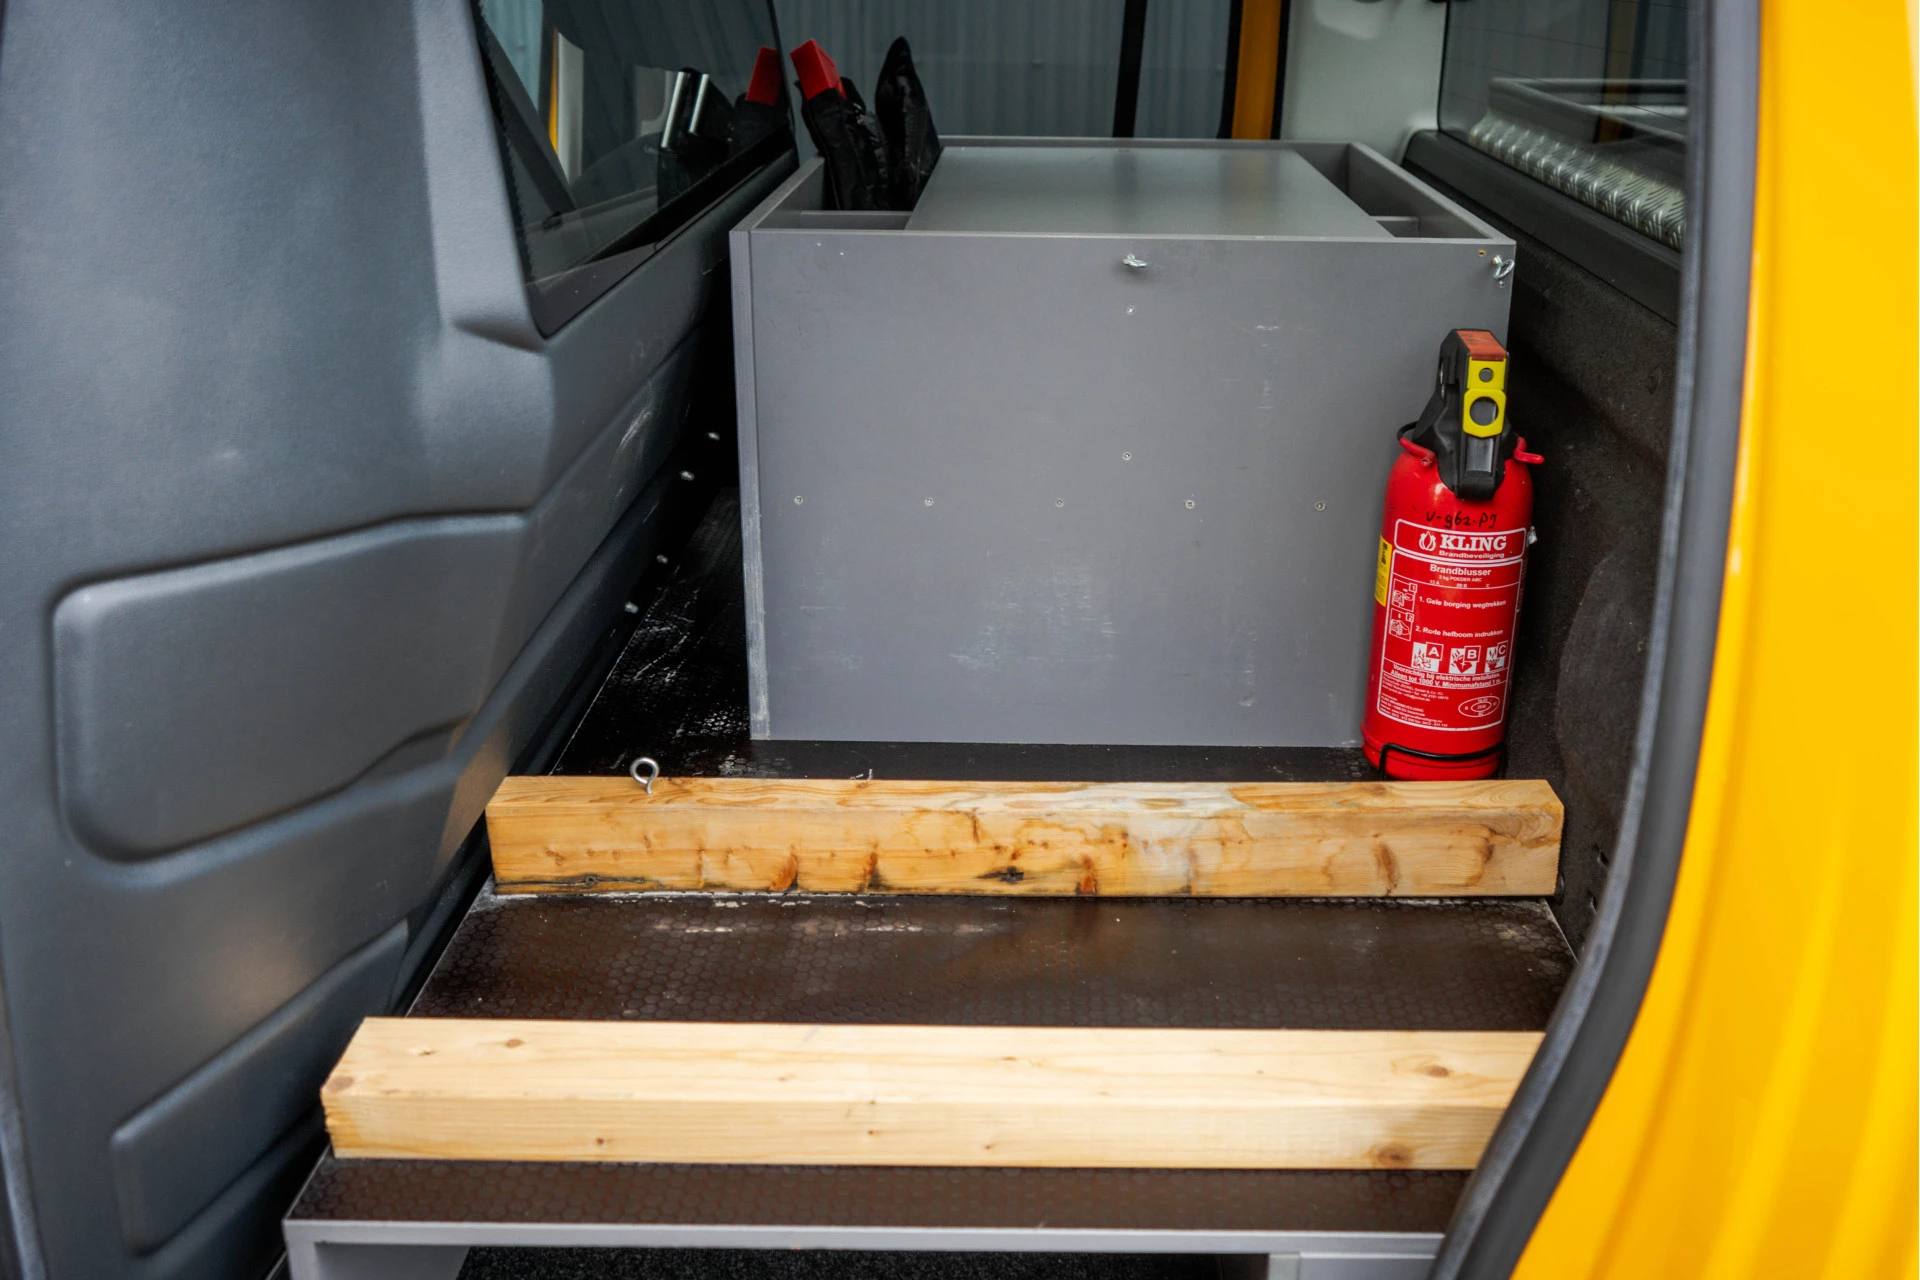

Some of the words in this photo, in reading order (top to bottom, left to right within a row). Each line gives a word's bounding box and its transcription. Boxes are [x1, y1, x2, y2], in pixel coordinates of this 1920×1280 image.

[1440, 533, 1507, 552] KLING
[1439, 550, 1504, 560] Brandbeveiliging
[1430, 564, 1492, 576] Brandblusser
[1426, 597, 1442, 606] Gele
[1444, 600, 1471, 609] borging
[1472, 600, 1507, 609] wegtrekken
[1422, 627, 1441, 636] Rode
[1442, 630, 1473, 638] hefboom
[1474, 629, 1504, 638] indrukken
[1428, 647, 1439, 657] A
[1467, 649, 1477, 659] B
[1498, 644, 1506, 655] C
[1393, 663, 1424, 679] Voorzichtig
[1426, 671, 1435, 680] bij
[1436, 674, 1471, 682] elektrische
[1390, 669, 1407, 681] Alleen
[1408, 674, 1417, 683] tot
[1419, 678, 1433, 687] 1000
[1442, 680, 1492, 688] Minimumafstand
